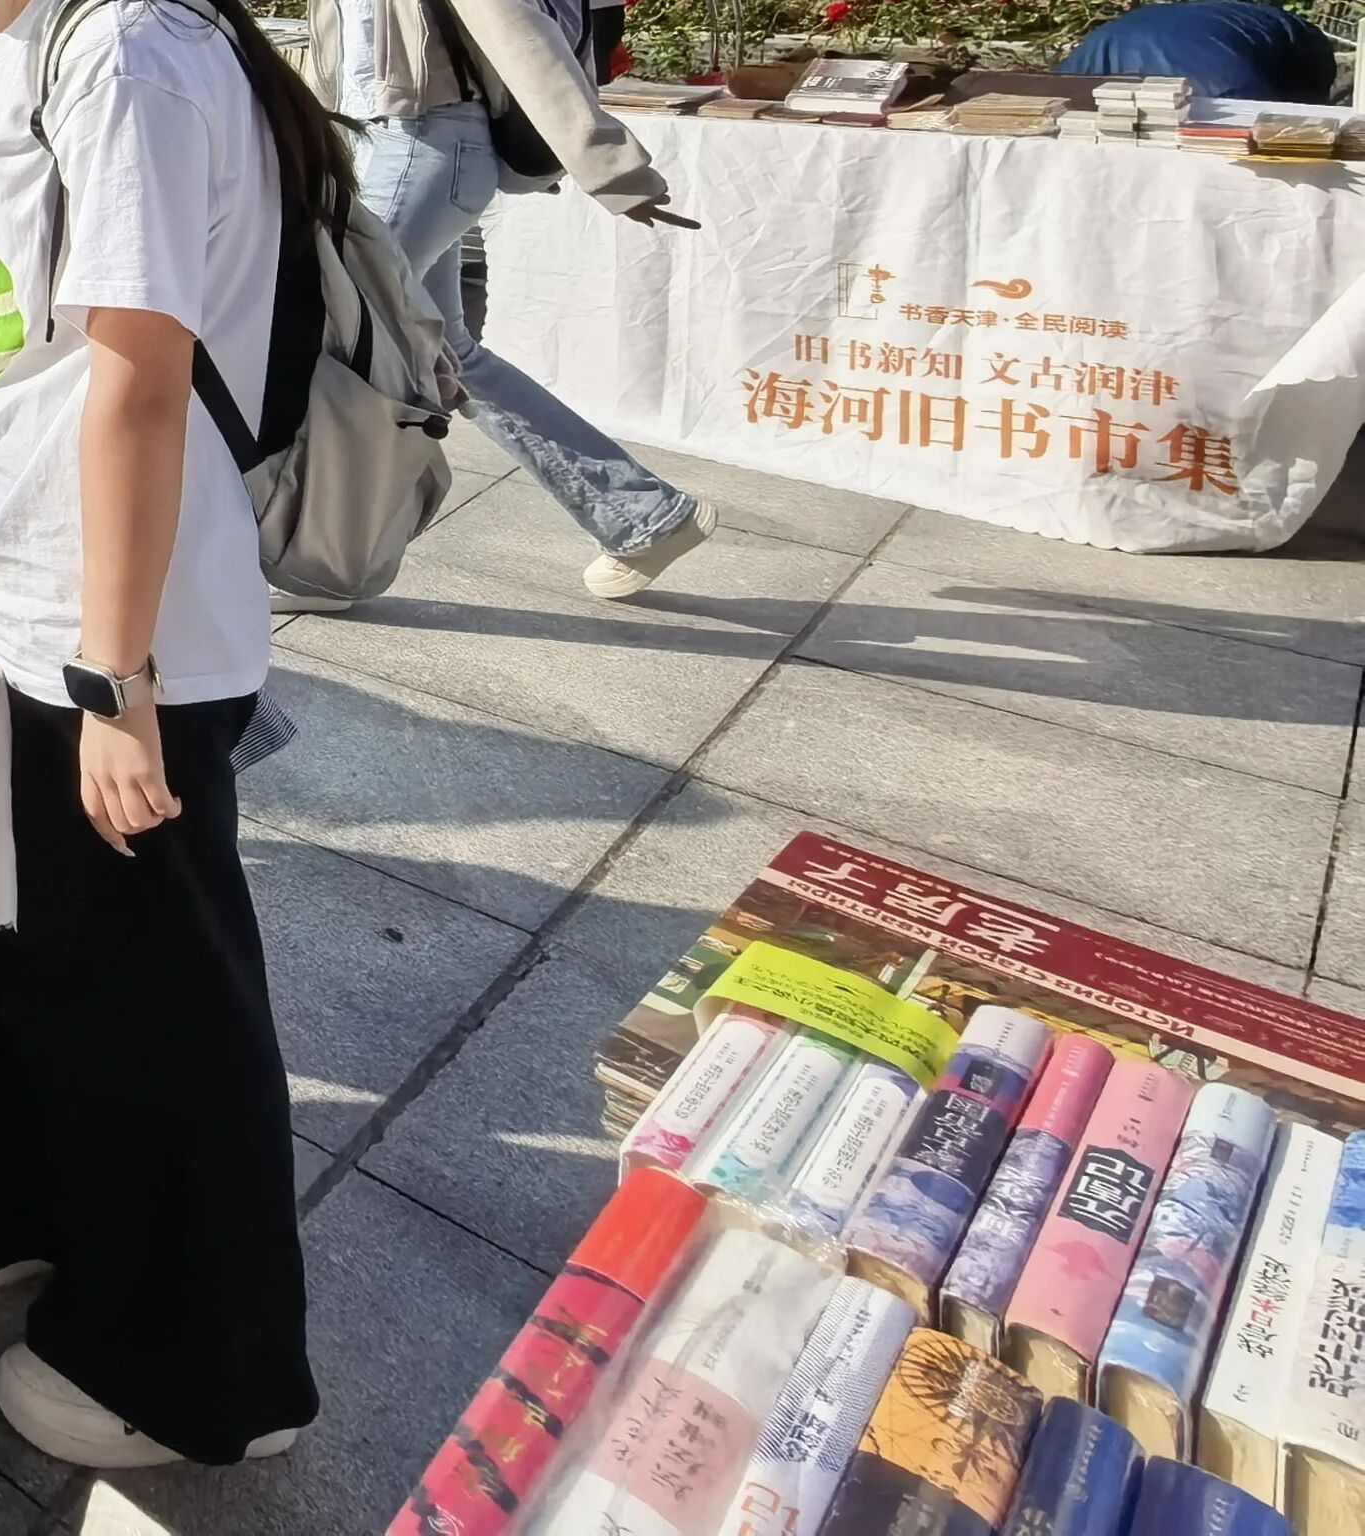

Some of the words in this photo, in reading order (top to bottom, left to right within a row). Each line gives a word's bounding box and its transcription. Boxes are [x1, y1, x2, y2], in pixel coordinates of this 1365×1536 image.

[899, 303, 1133, 341] 书香天津·全民阅读
[794, 333, 963, 381] 旧书新知
[980, 350, 1181, 407] 文古润津
[740, 368, 1240, 497] 海河旧书市集
[786, 876, 934, 941] квартиры
[804, 859, 1050, 958] 老房子
[935, 935, 1049, 985] старой
[1053, 967, 1196, 1040] История
[916, 1092, 991, 1177] 蒙古帝国
[1235, 1254, 1293, 1360] 战后日本经济史
